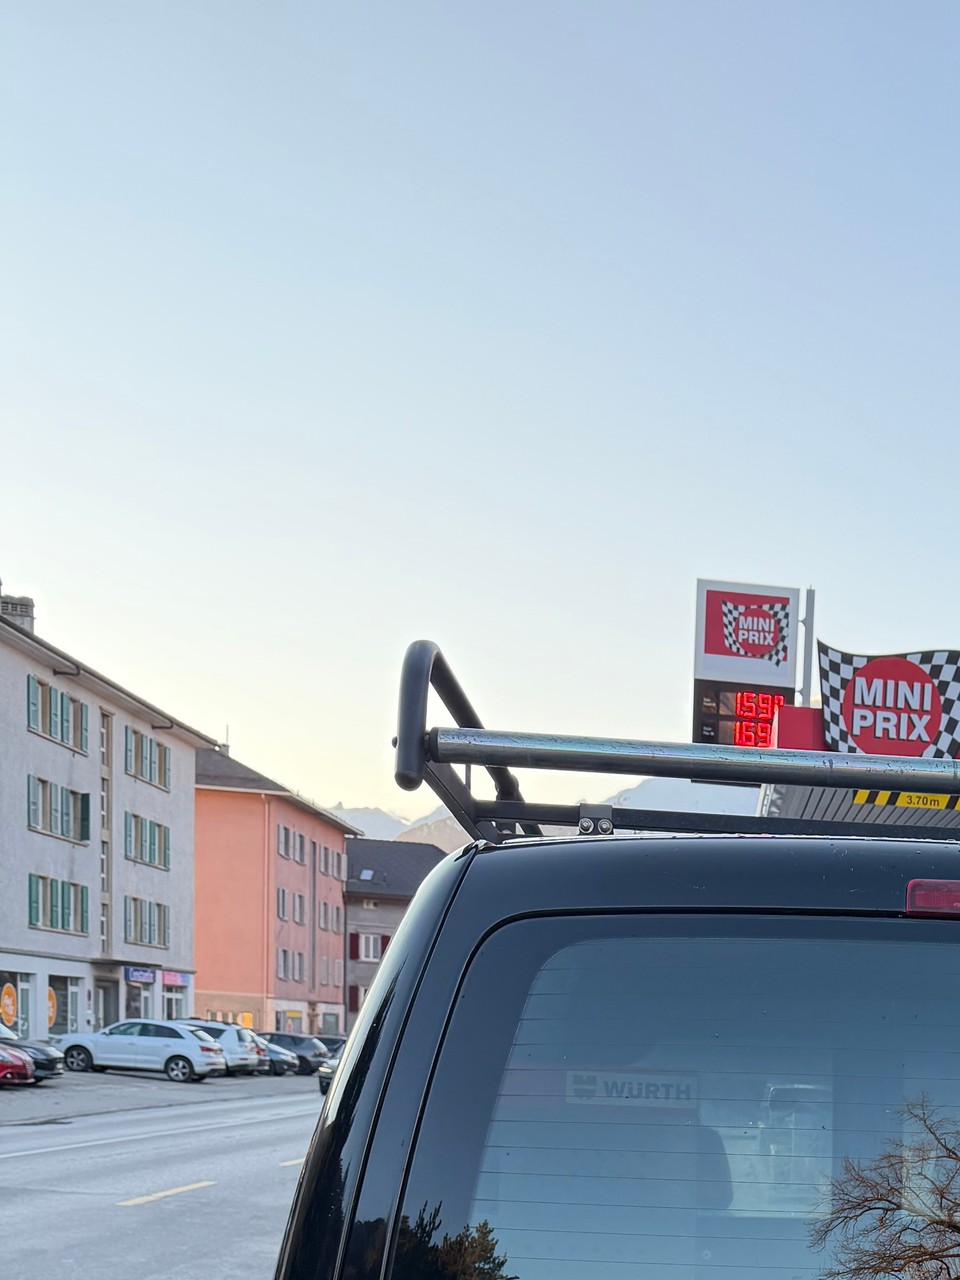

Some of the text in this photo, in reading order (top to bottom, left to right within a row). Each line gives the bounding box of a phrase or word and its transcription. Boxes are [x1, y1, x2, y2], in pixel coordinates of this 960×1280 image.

[738, 615, 775, 632] MINI
[738, 629, 775, 646] PRIX
[853, 676, 932, 712] MINI
[852, 708, 931, 743] PRIX
